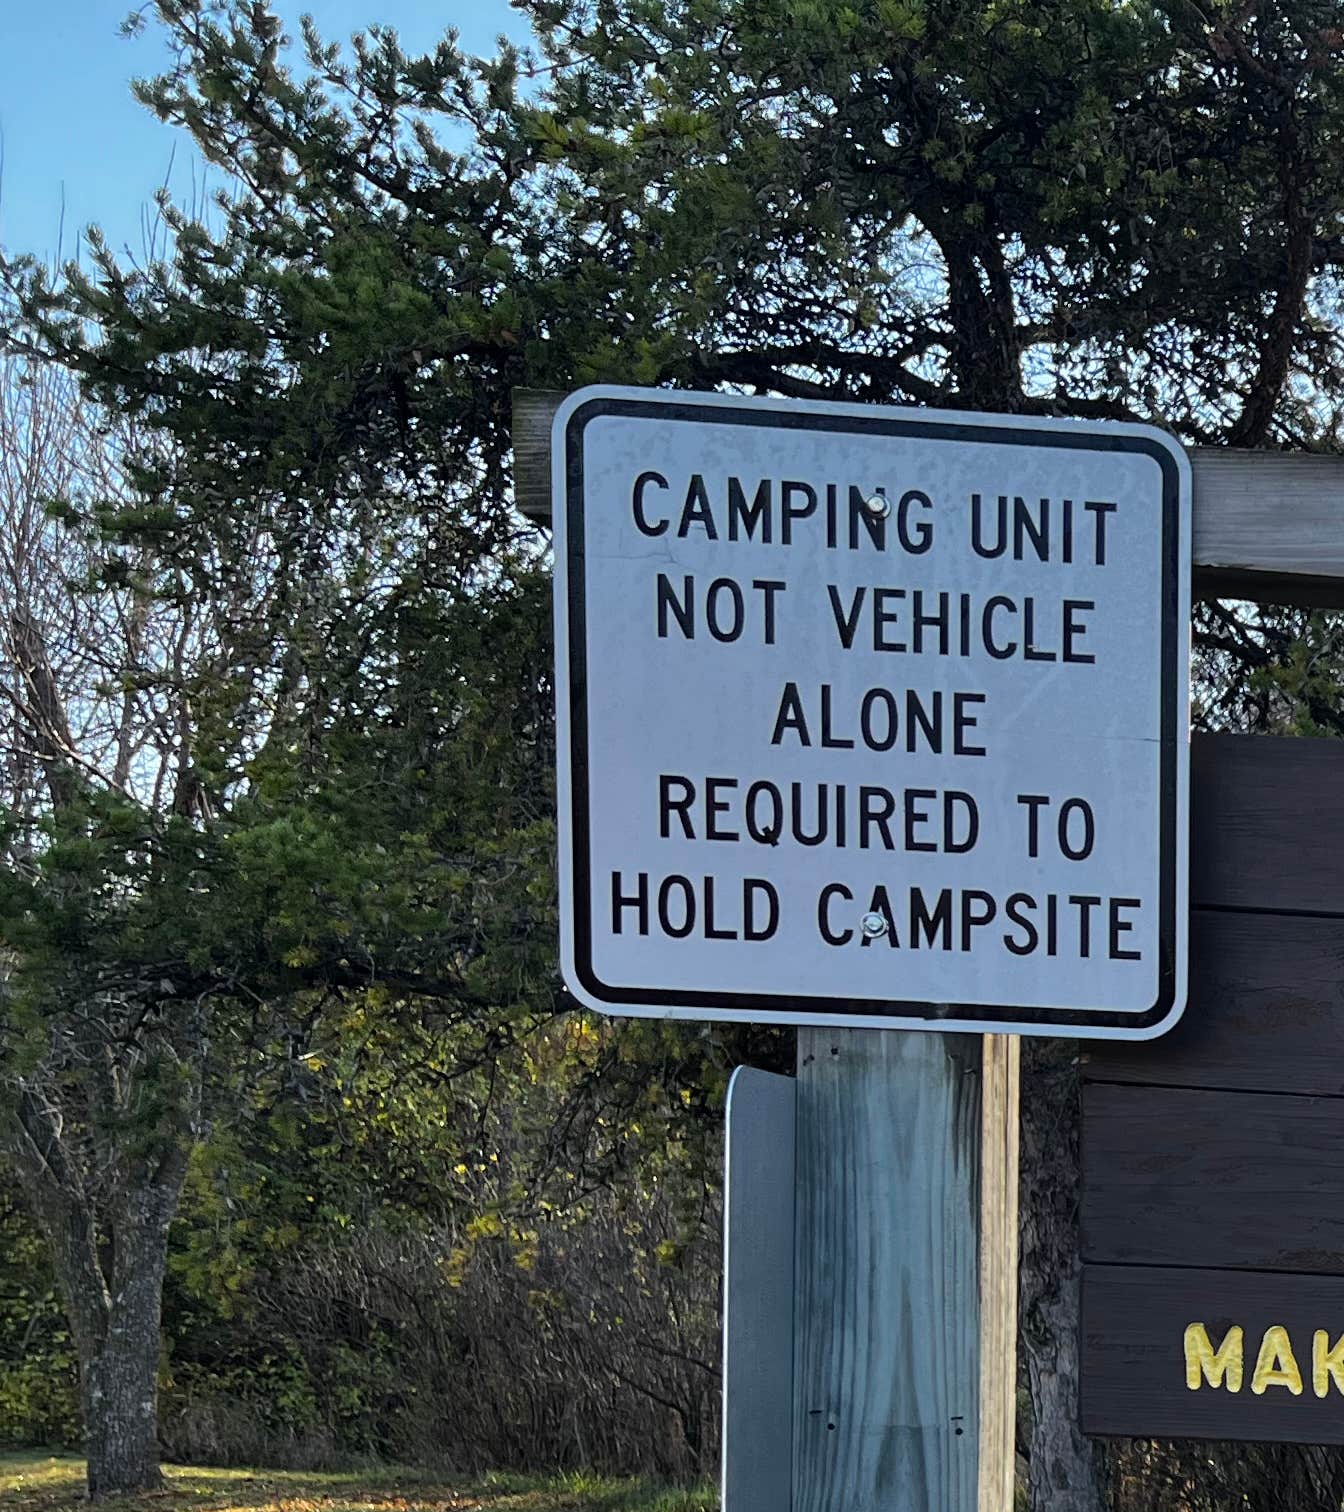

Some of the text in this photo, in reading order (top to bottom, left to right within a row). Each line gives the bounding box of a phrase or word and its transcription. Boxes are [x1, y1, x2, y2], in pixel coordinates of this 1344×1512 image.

[633, 472, 1117, 565] CAMPING UNIT
[657, 574, 1095, 664] NOT VEHICLE
[771, 683, 986, 756] ALONE
[660, 775, 1094, 861] REQUIRED TO
[612, 872, 1141, 960] HOLD CAMPSITE
